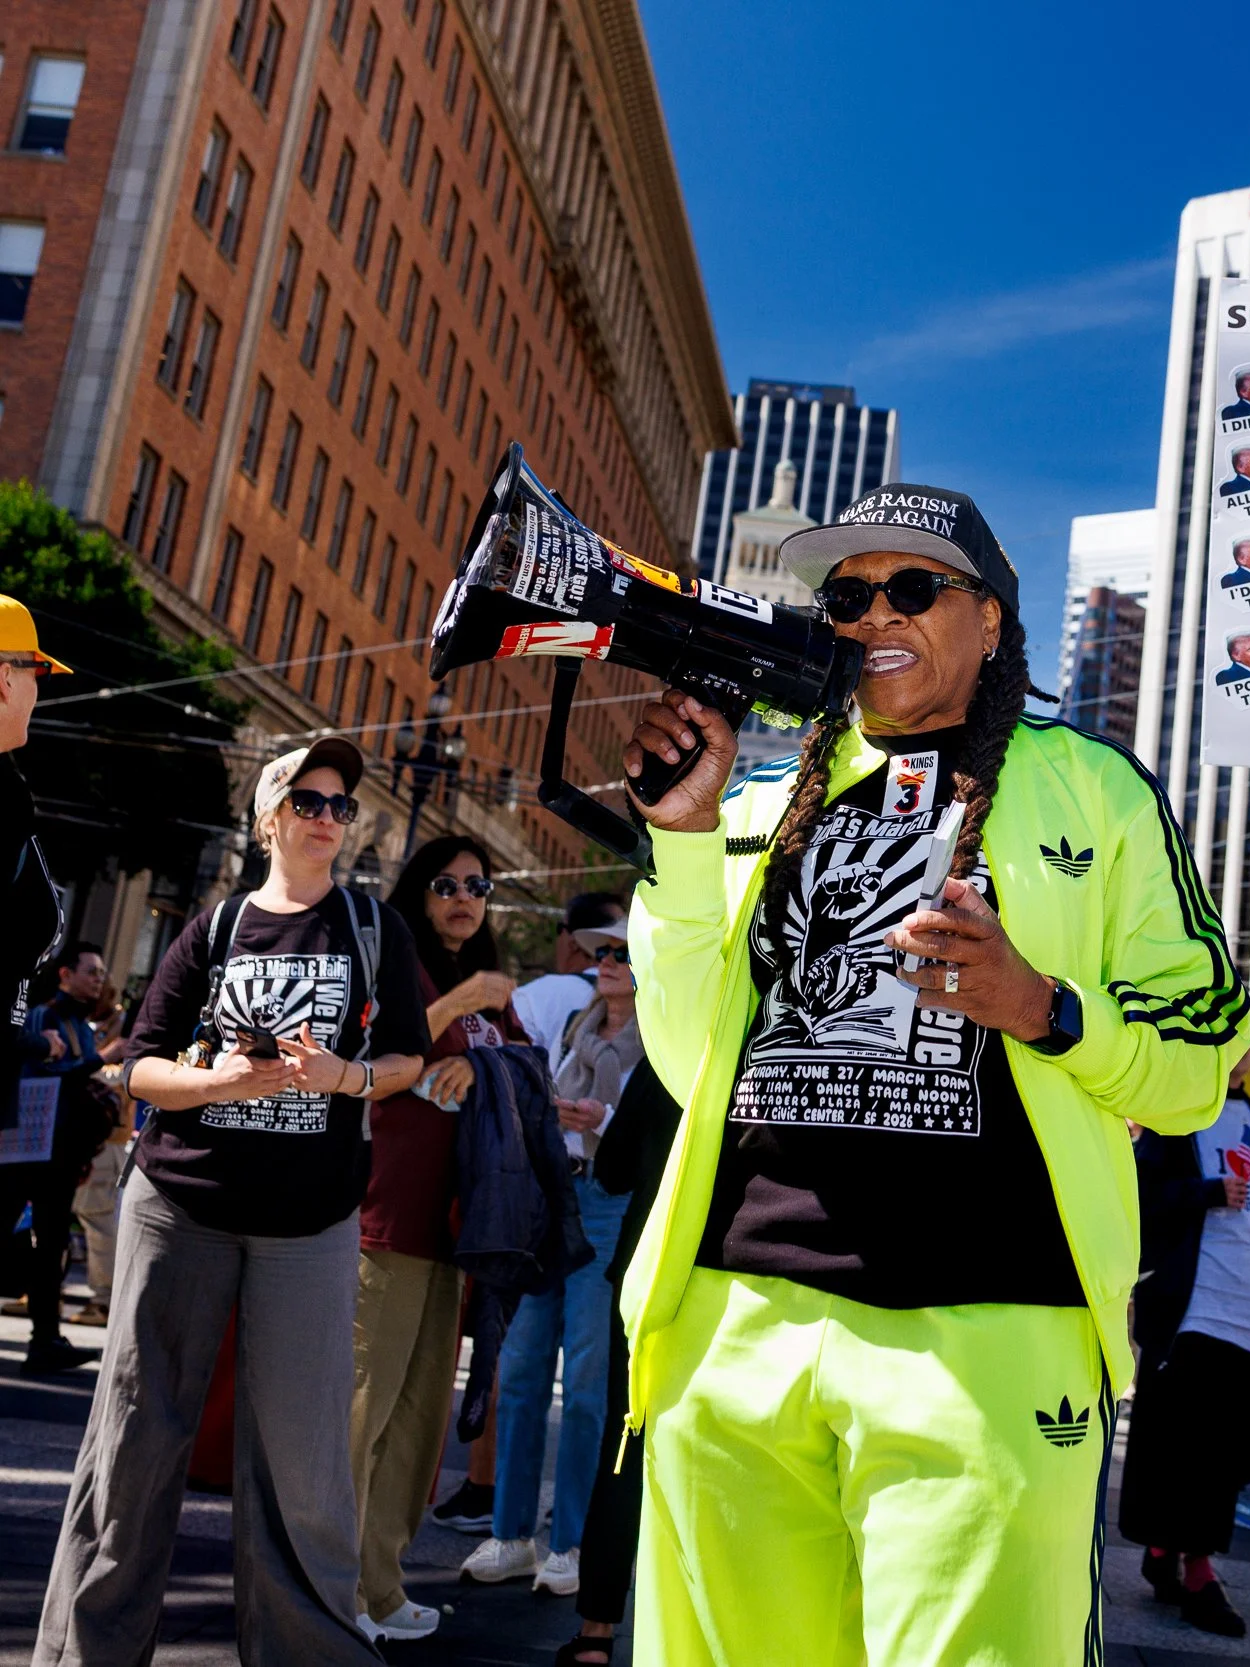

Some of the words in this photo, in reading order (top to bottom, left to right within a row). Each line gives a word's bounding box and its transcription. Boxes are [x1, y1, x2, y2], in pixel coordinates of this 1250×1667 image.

[1222, 423, 1227, 433] I
[839, 496, 875, 523] MAKE
[878, 493, 959, 518] RACISM
[888, 510, 955, 538] AGAIN
[538, 537, 551, 575] They're
[552, 537, 561, 554] the
[573, 533, 588, 573] MUST
[545, 556, 561, 594] Streets
[530, 577, 546, 602] Gone
[1229, 587, 1250, 600] I'D
[750, 656, 775, 670] AUX/MP3
[1225, 686, 1231, 697] I
[910, 755, 934, 769] KINGS
[893, 785, 921, 814] 3
[863, 810, 933, 838] March
[266, 960, 305, 977] March
[319, 960, 348, 980] Rally
[314, 983, 345, 1018] We
[793, 1065, 830, 1079] JUNE
[873, 1069, 925, 1086] MARCH
[935, 1074, 970, 1091] 10AM
[766, 1082, 793, 1093] 11AM
[817, 1083, 859, 1096] DANCE
[868, 1085, 908, 1099] STAGE
[919, 1089, 959, 1104] NOON
[804, 1108, 844, 1122] CENTER
[864, 1111, 877, 1125] SF
[883, 1112, 913, 1128] 2026
[819, 1097, 860, 1109] PLAZA
[890, 1101, 950, 1115] MARKET
[958, 1106, 973, 1117] ST
